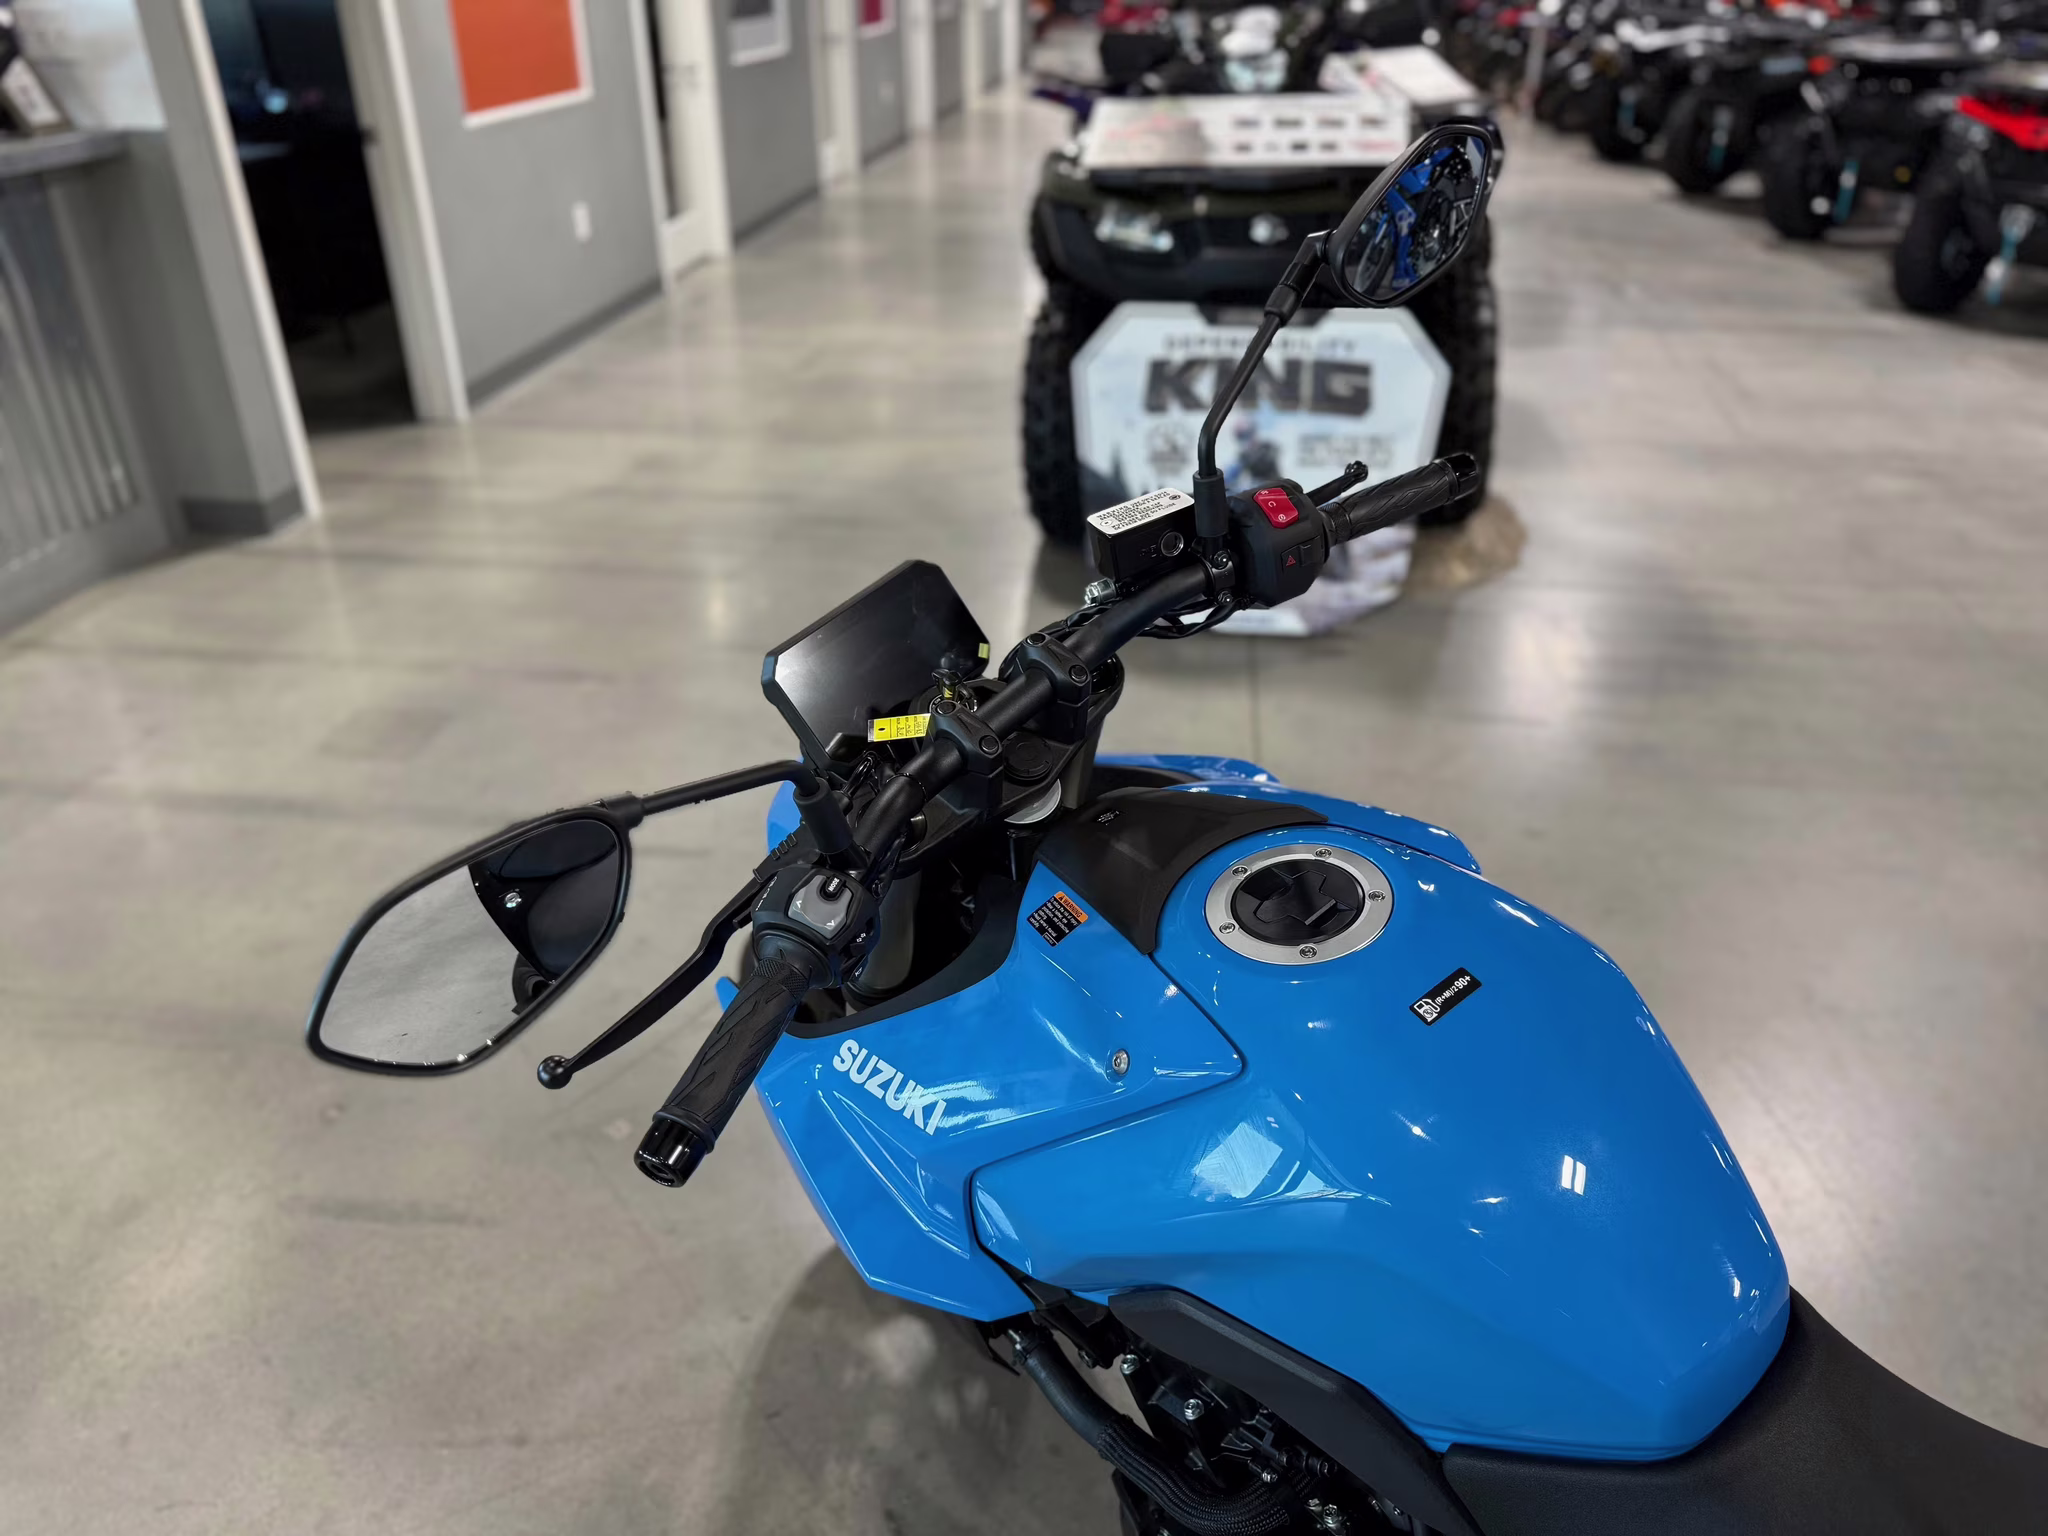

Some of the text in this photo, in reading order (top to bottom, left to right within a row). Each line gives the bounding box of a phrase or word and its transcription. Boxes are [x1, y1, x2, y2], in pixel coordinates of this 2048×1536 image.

[828, 877, 839, 892] MODE
[1063, 897, 1083, 918] WARNING
[1436, 976, 1471, 1006] (R+M)/2 90+
[832, 1039, 947, 1136] SUZUKI
